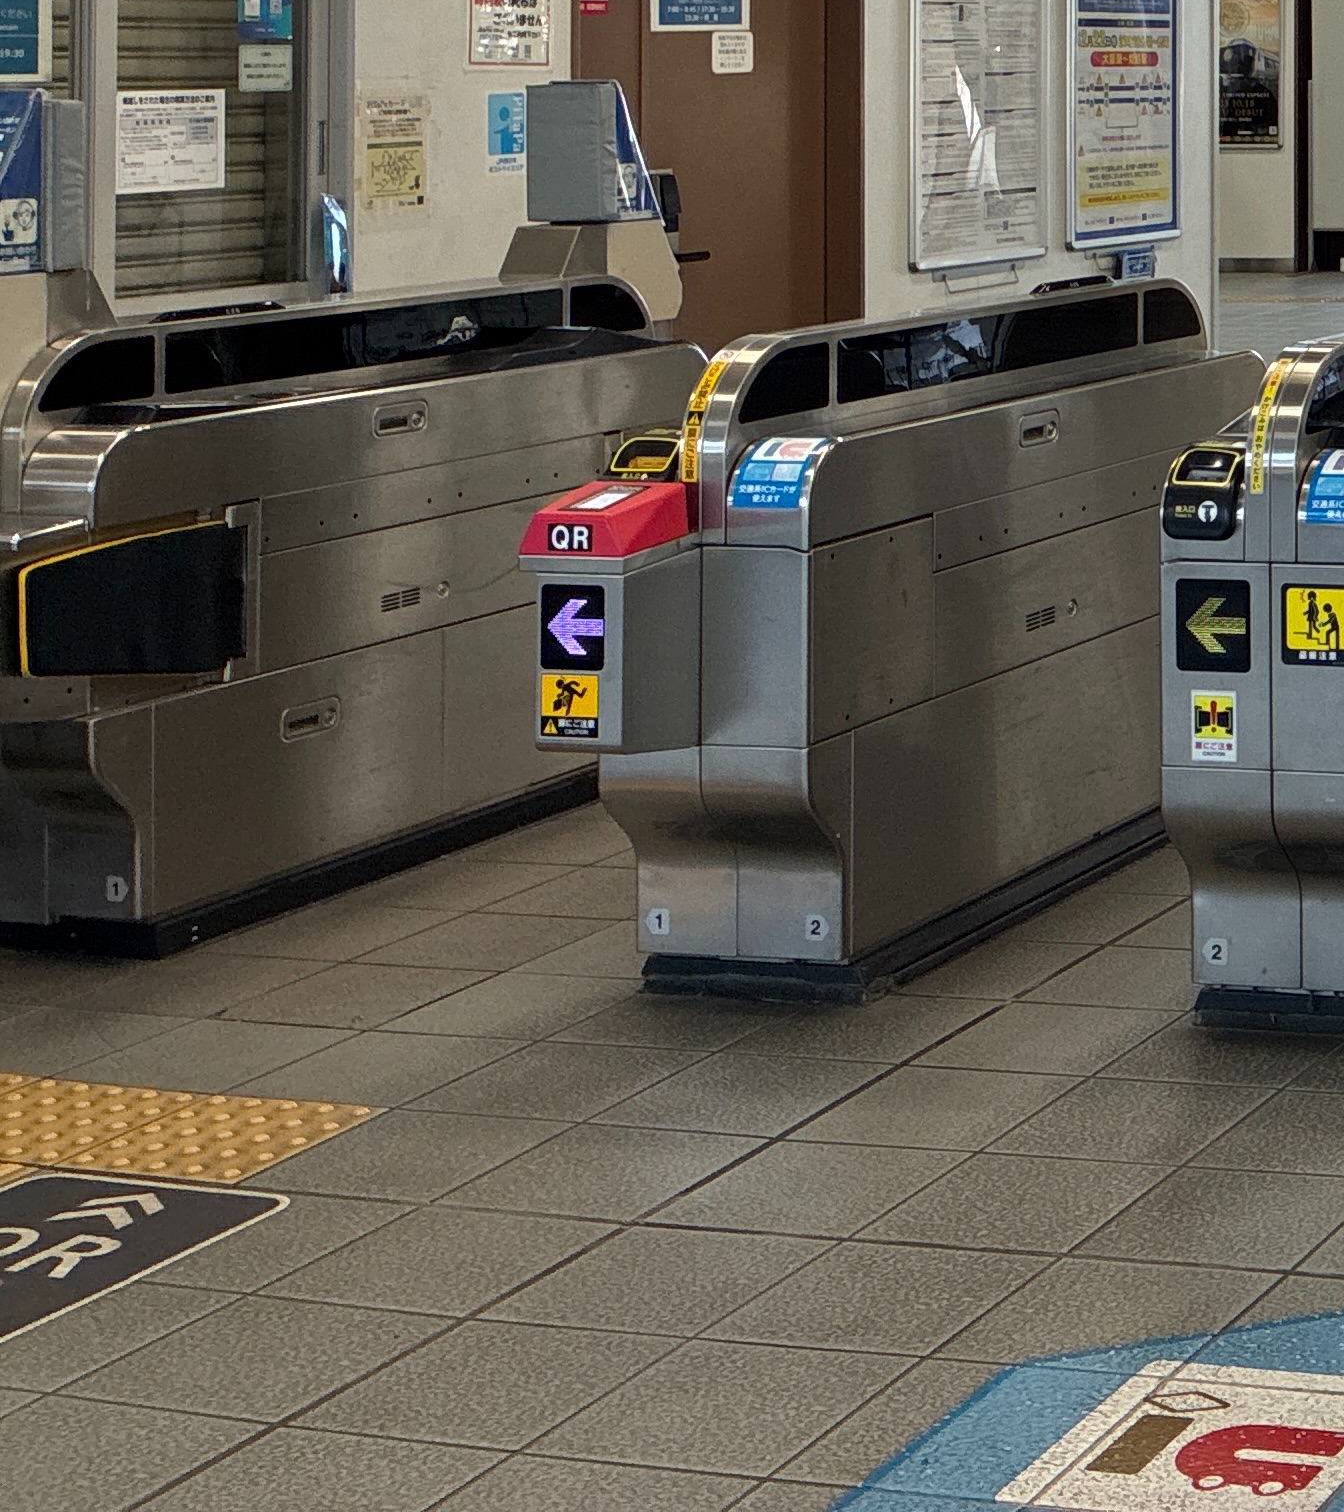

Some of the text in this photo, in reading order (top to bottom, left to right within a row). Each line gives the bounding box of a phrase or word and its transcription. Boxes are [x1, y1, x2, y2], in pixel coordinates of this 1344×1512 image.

[551, 526, 589, 551] QR
[112, 882, 119, 896] 1
[655, 914, 662, 929] 1
[810, 919, 820, 936] 2
[1212, 944, 1222, 961] 2
